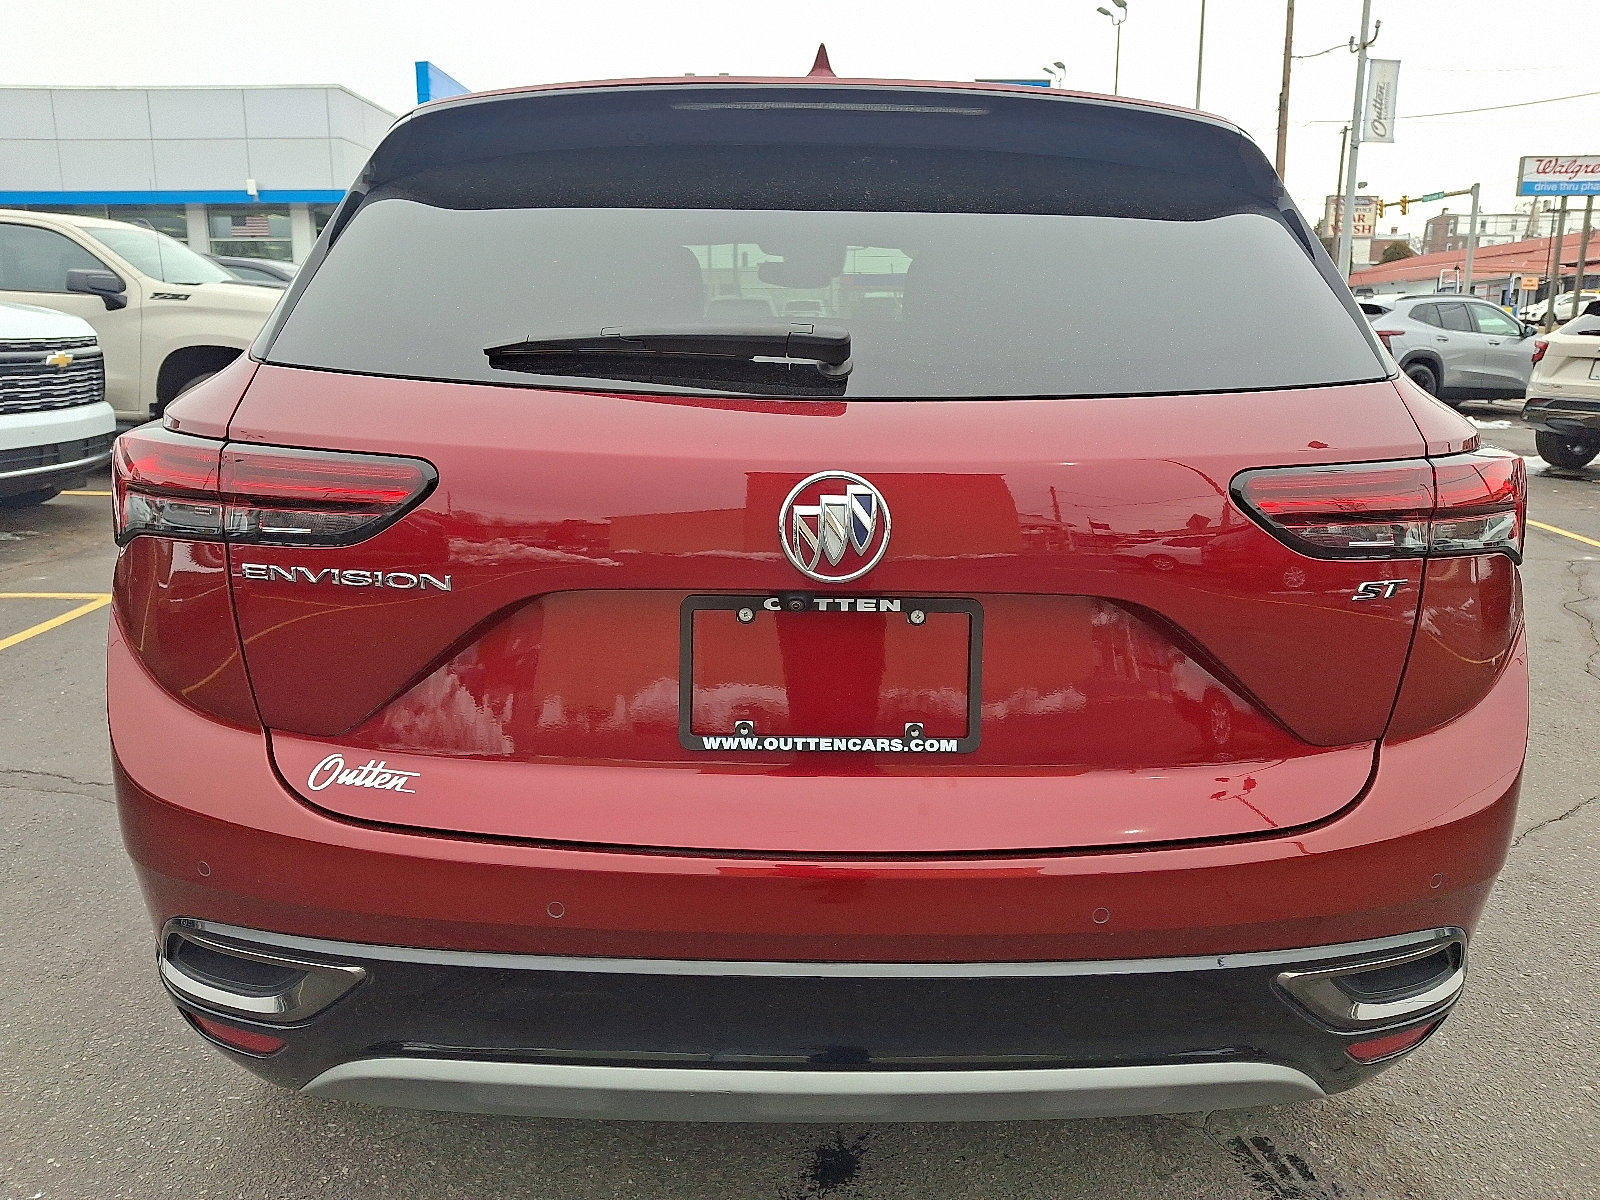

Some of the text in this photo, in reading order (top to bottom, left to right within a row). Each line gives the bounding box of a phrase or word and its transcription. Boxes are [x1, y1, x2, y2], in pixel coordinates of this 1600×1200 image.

[1371, 81, 1387, 138] Outten
[1534, 182, 1557, 191] drive
[1560, 182, 1578, 191] thru
[241, 562, 452, 591] ENVISION
[1351, 579, 1409, 601] ST
[763, 597, 901, 612] OTTEN
[702, 737, 958, 752] WWW.OUTTENCARS.COM
[307, 753, 421, 794] Outten
